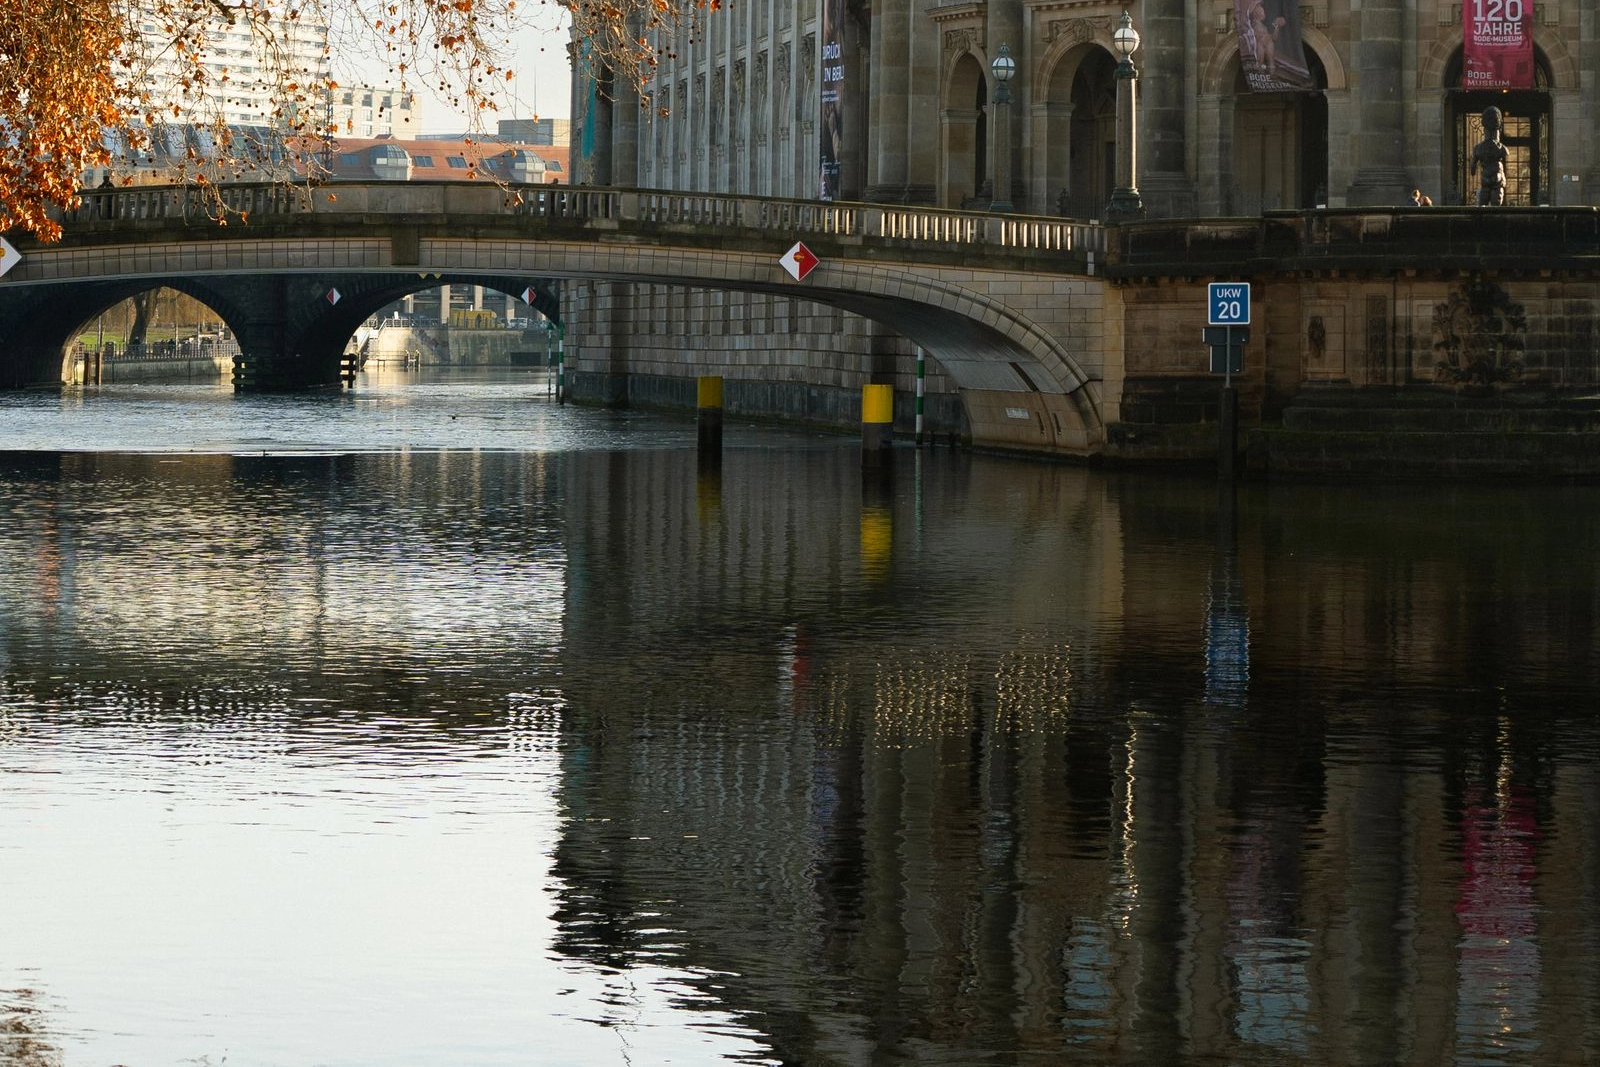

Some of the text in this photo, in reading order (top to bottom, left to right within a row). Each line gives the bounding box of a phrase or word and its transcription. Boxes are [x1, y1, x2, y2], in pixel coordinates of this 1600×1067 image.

[1473, 22, 1523, 36] JAHRE
[824, 67, 831, 82] IN
[1249, 72, 1273, 82] BODE
[1467, 70, 1493, 80] BODE
[1467, 79, 1510, 87] MUSEUM
[1216, 288, 1242, 299] UKW
[1218, 301, 1241, 319] 20
